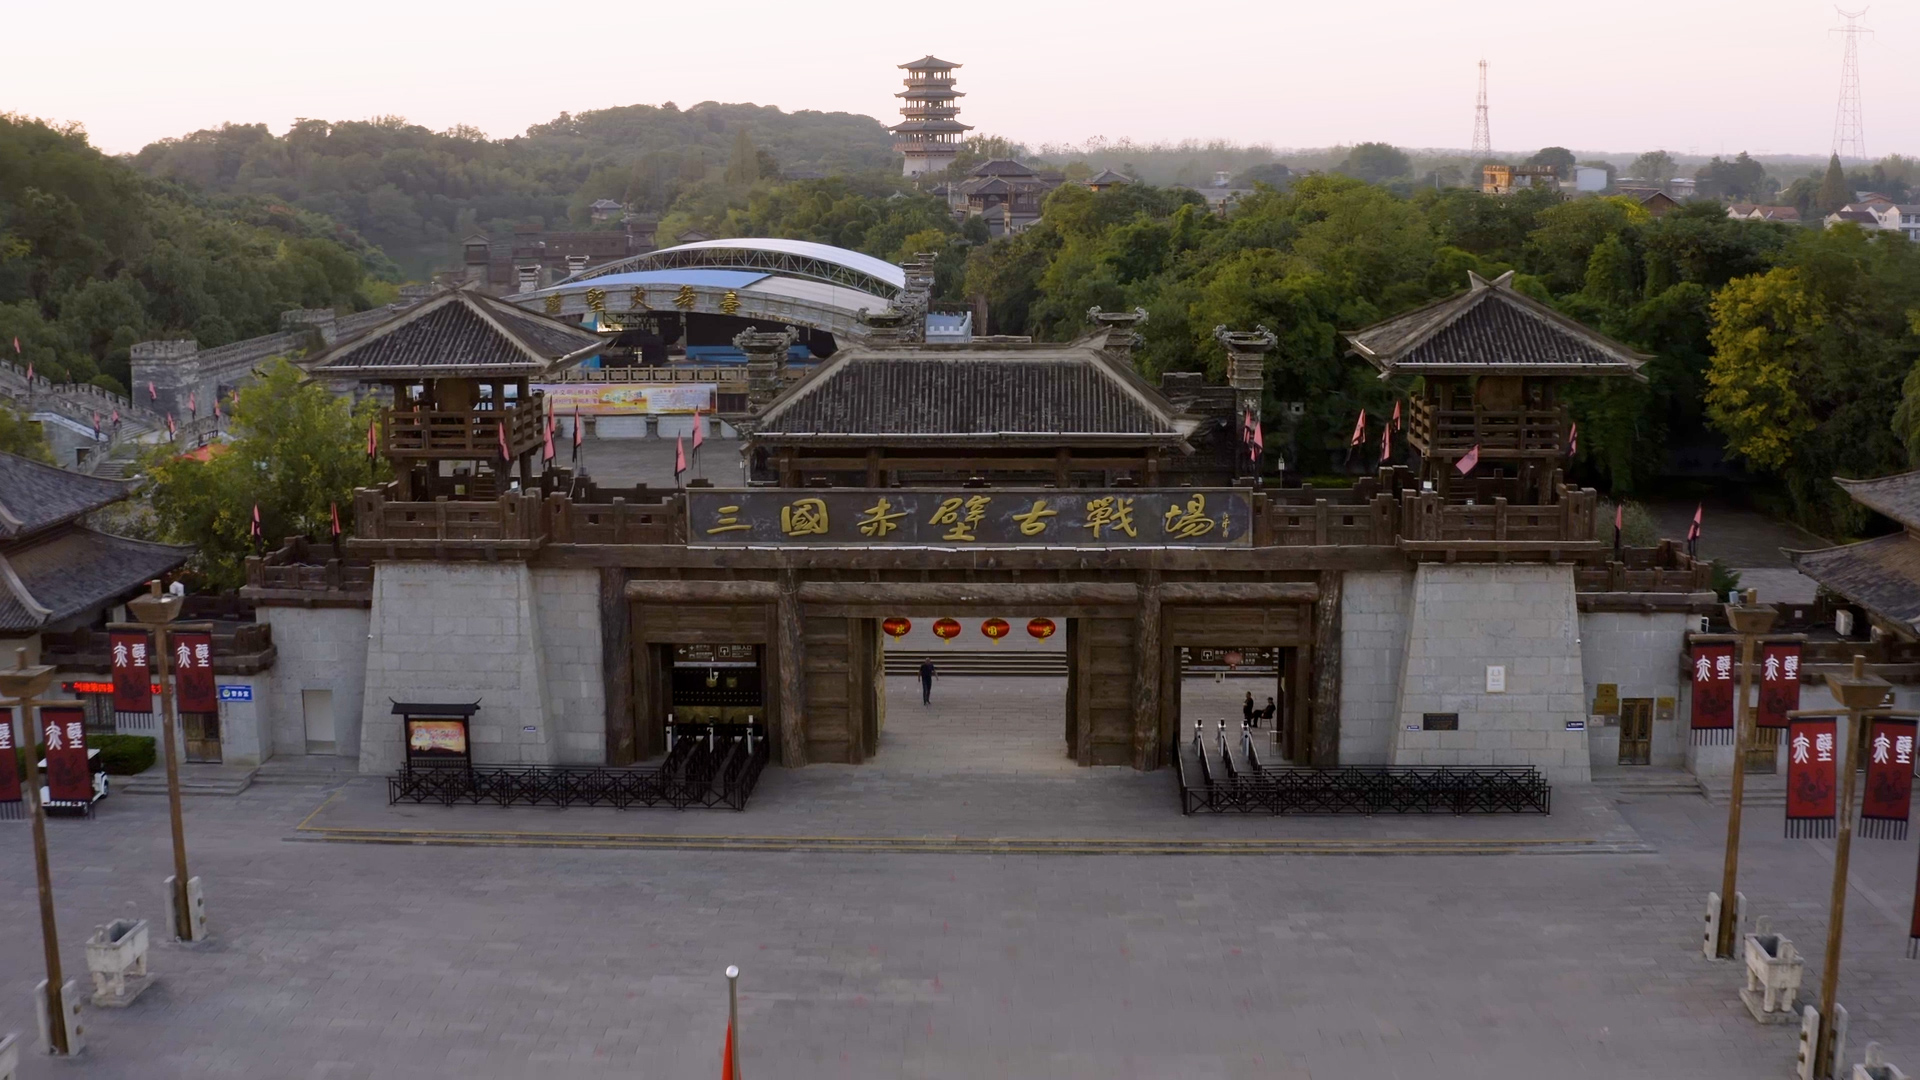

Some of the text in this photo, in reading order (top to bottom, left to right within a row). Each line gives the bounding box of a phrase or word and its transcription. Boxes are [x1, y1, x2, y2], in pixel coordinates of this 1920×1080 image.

[707, 493, 1215, 542] 三國赤壁古戰場
[113, 642, 146, 668] 赤壁
[177, 642, 210, 669] 赤壁
[1696, 654, 1731, 682] 赤壁
[1764, 654, 1799, 681] 赤壁
[45, 721, 83, 750] 赤壁
[1792, 732, 1833, 764] 赤壁
[1873, 732, 1913, 765] 赤壁
